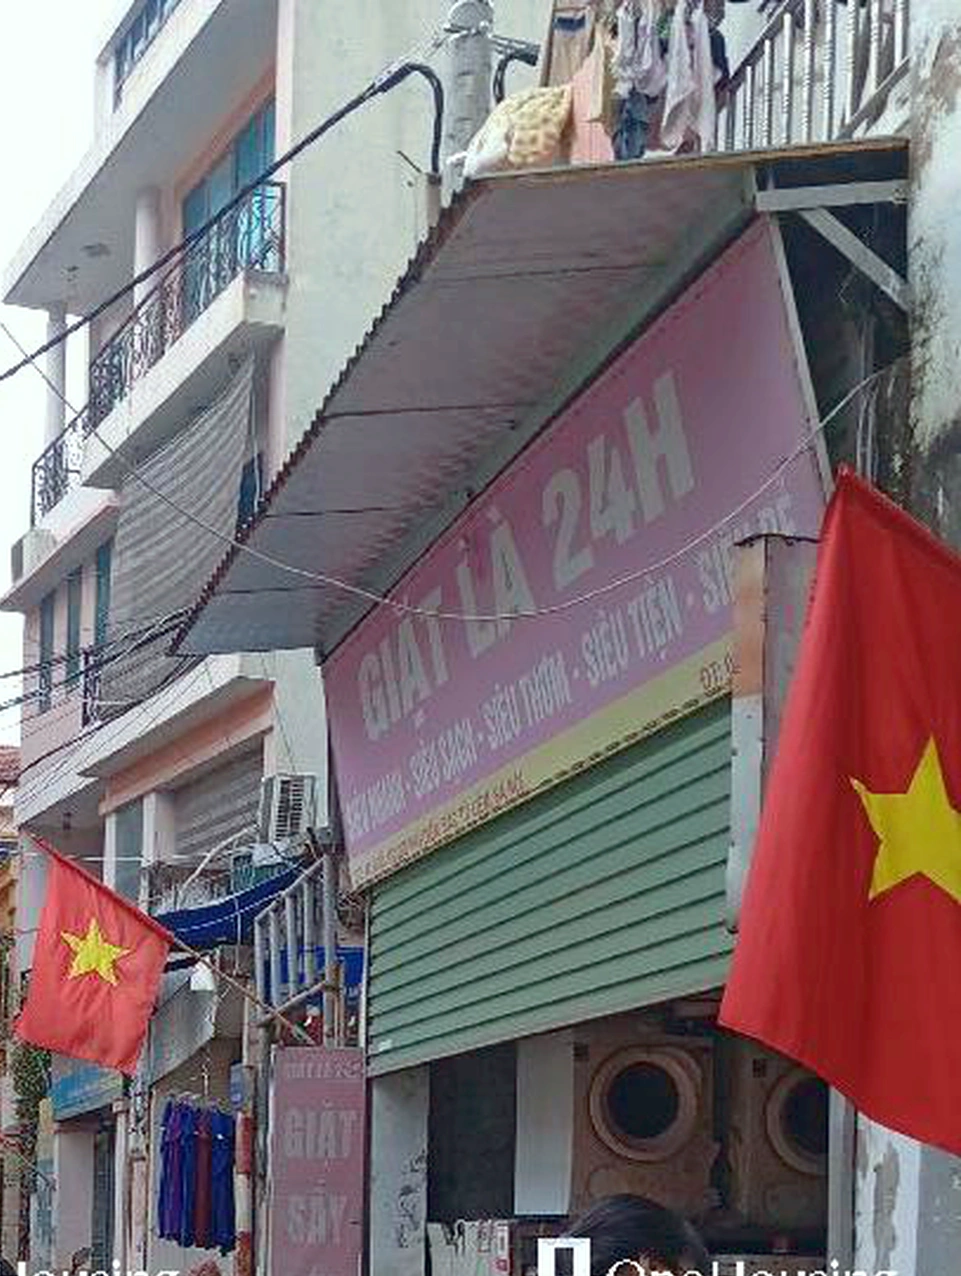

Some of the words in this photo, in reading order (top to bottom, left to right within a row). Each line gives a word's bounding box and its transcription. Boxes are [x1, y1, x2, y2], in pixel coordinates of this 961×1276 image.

[455, 505, 535, 658] LÀ
[542, 372, 694, 591] 24H
[482, 682, 521, 750] SIÊU
[581, 608, 628, 688] SIÊU
[628, 573, 683, 661] TIỆN
